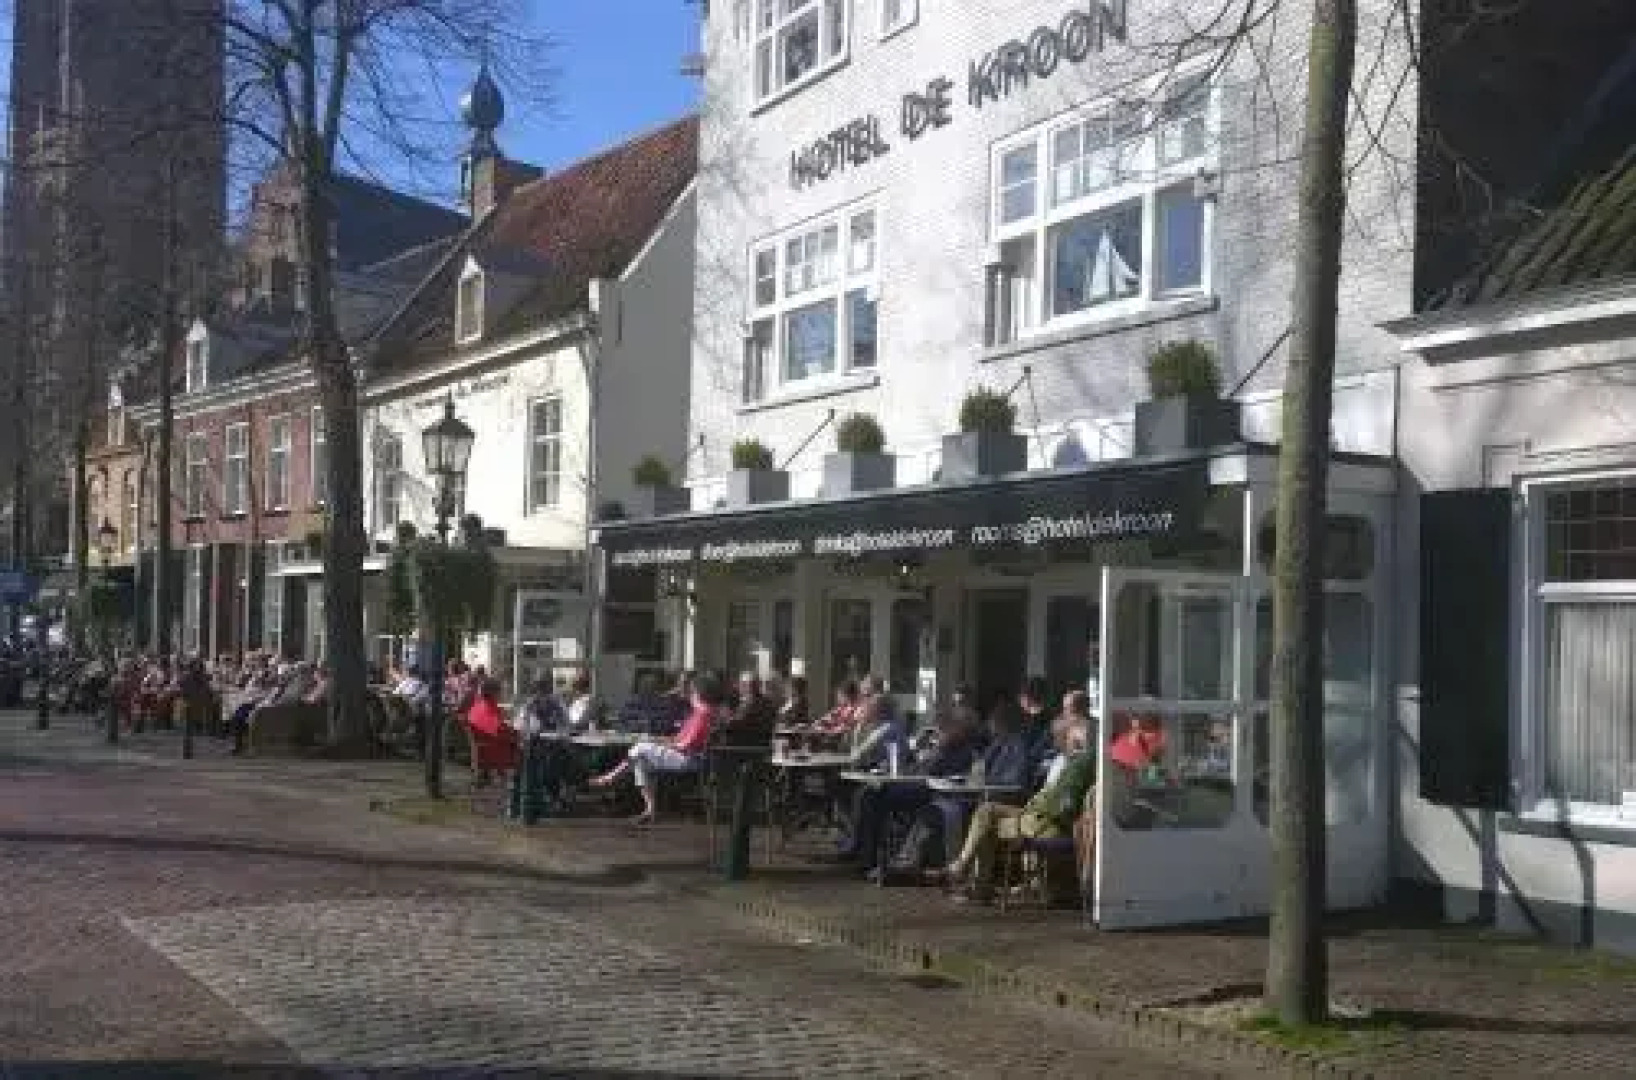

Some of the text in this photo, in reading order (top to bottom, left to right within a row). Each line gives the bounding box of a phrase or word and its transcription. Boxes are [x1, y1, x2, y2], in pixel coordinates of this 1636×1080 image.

[789, 0, 1127, 191] HOTEL DE KROON
